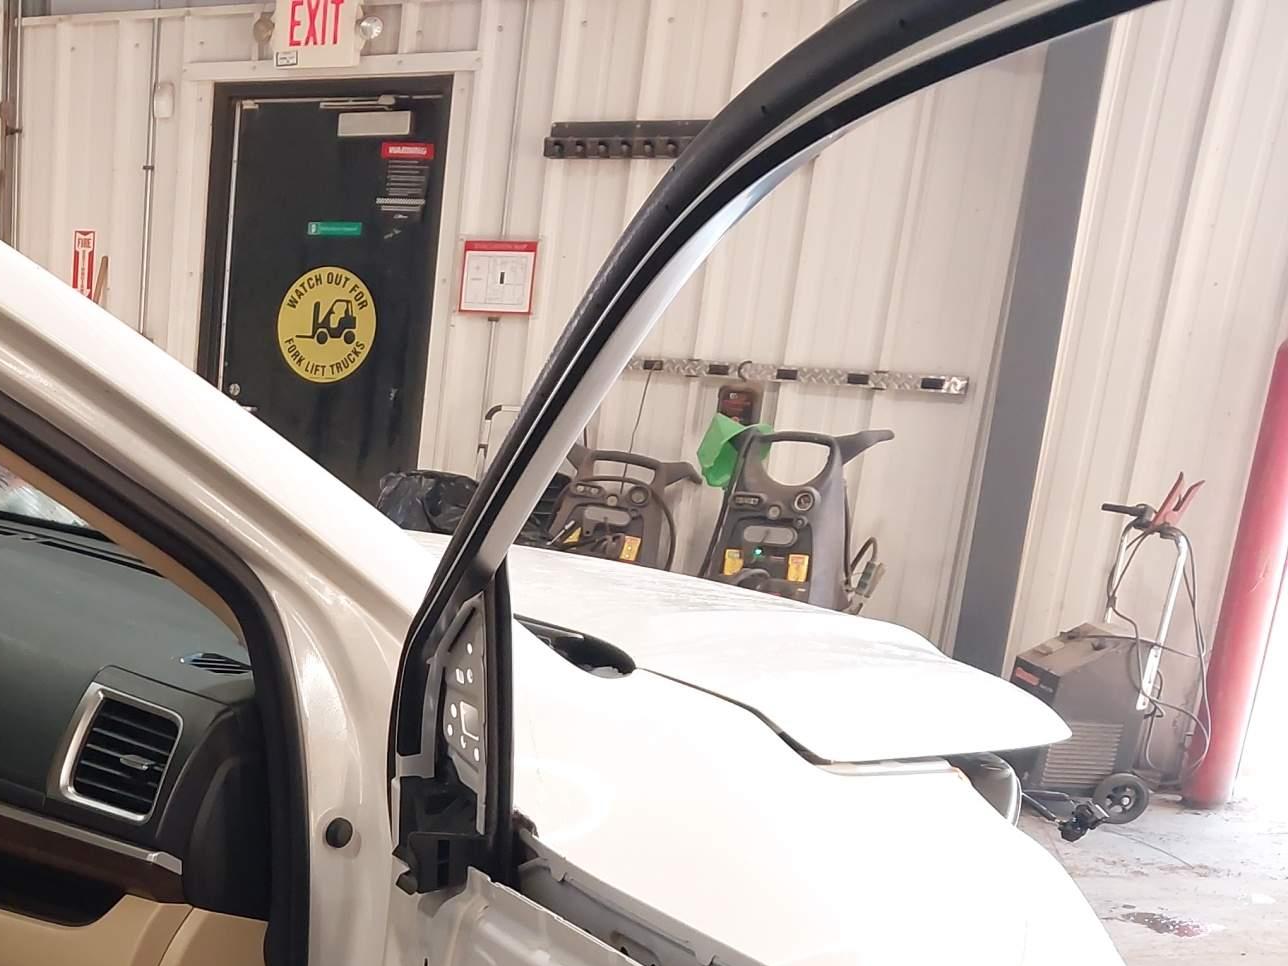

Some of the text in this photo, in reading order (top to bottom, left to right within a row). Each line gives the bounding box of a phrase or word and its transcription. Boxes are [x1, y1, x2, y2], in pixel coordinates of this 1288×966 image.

[289, 0, 344, 46] EXIT
[78, 238, 91, 248] FIRE
[286, 271, 369, 311] WATCH OUT FOR
[284, 337, 366, 377] FORK LIFT TRUCKS
